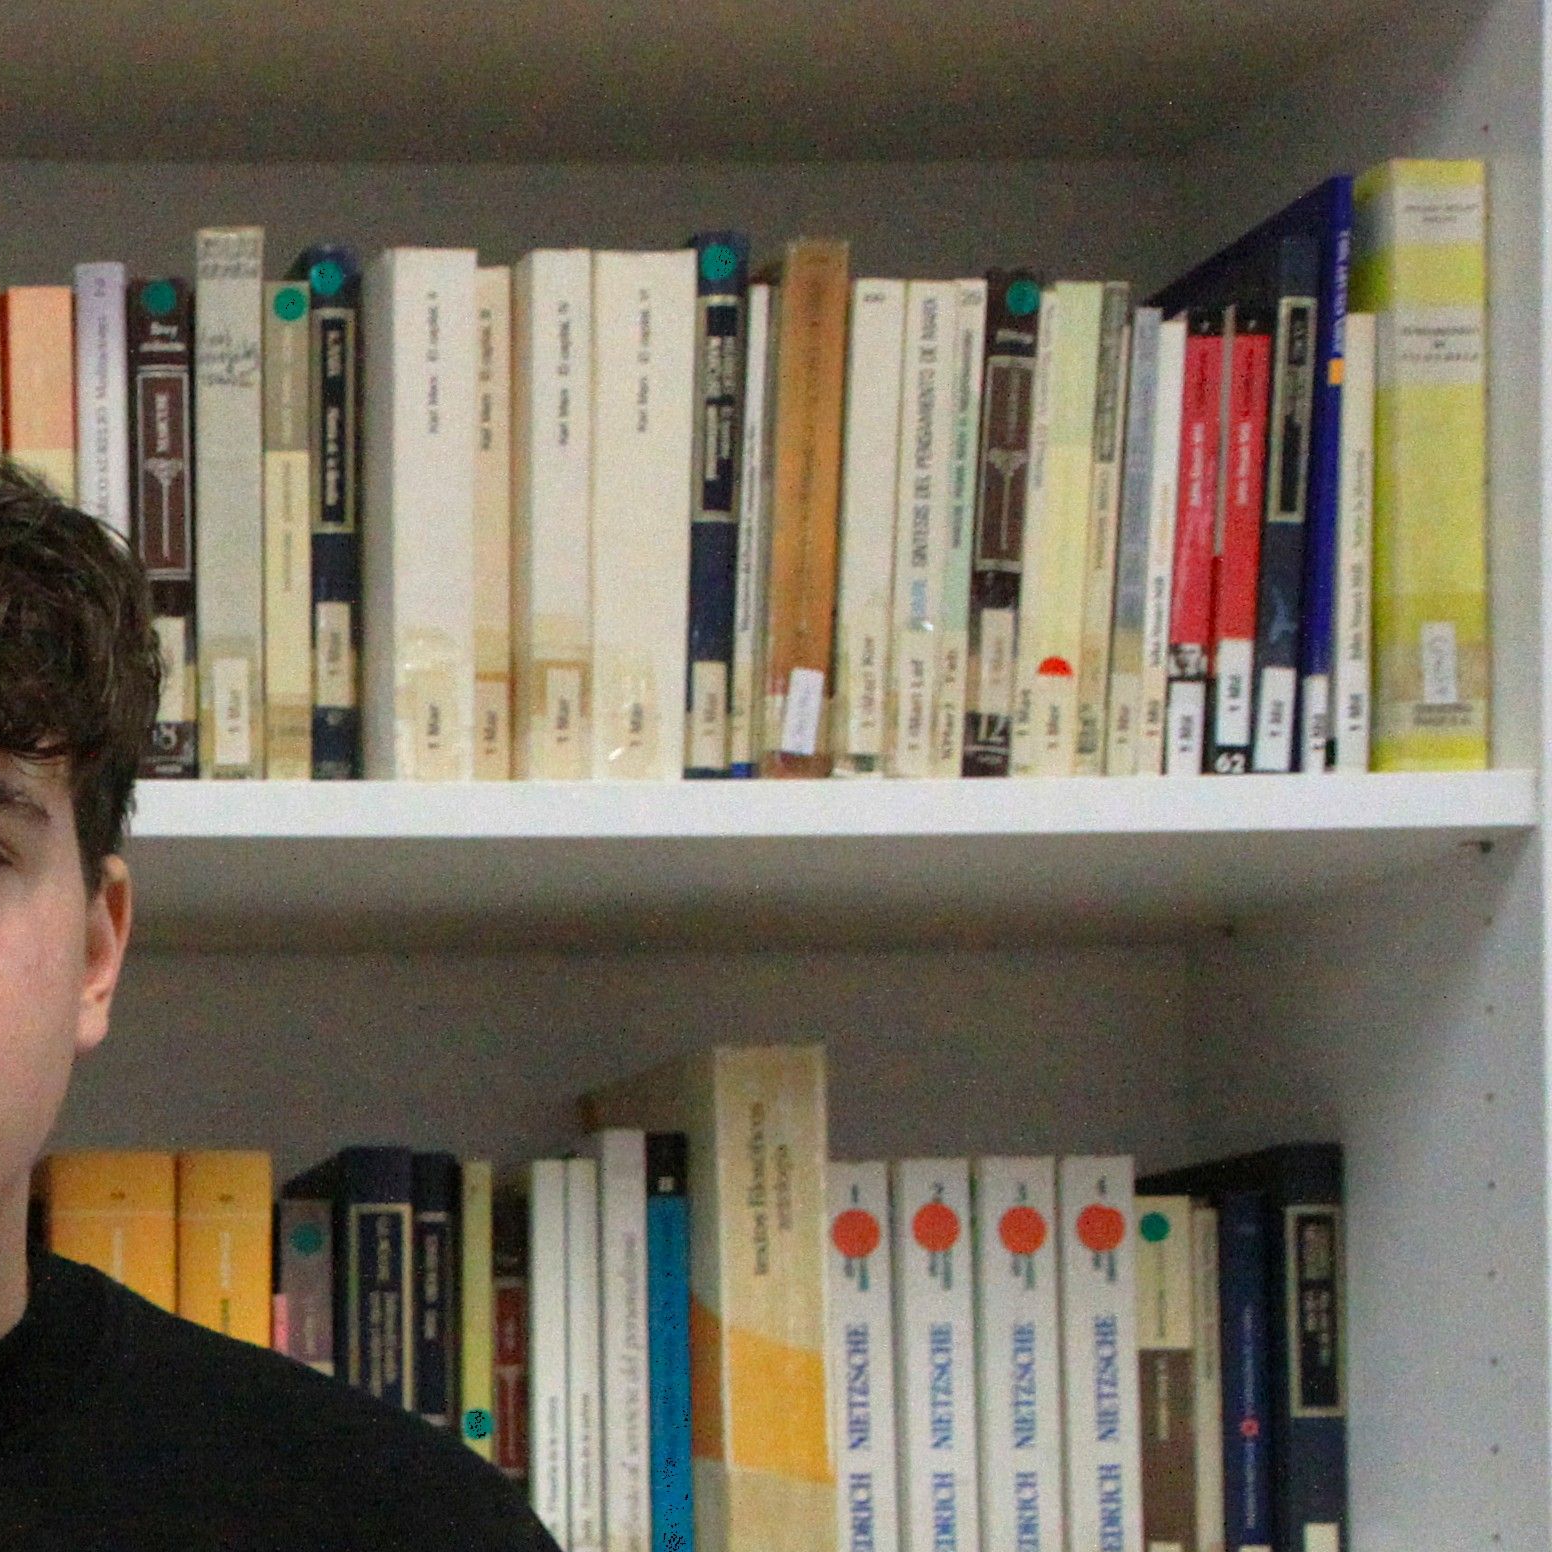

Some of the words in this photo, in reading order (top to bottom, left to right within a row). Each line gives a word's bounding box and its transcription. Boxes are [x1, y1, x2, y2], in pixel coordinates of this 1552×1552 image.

[846, 1323, 871, 1451] NIETZSCHE
[930, 1322, 953, 1450] NIETZSCHE
[1012, 1322, 1036, 1450] NIETZSCHE
[1094, 1315, 1119, 1442] NIETZSCHE
[1098, 1465, 1123, 1552] EDRICH
